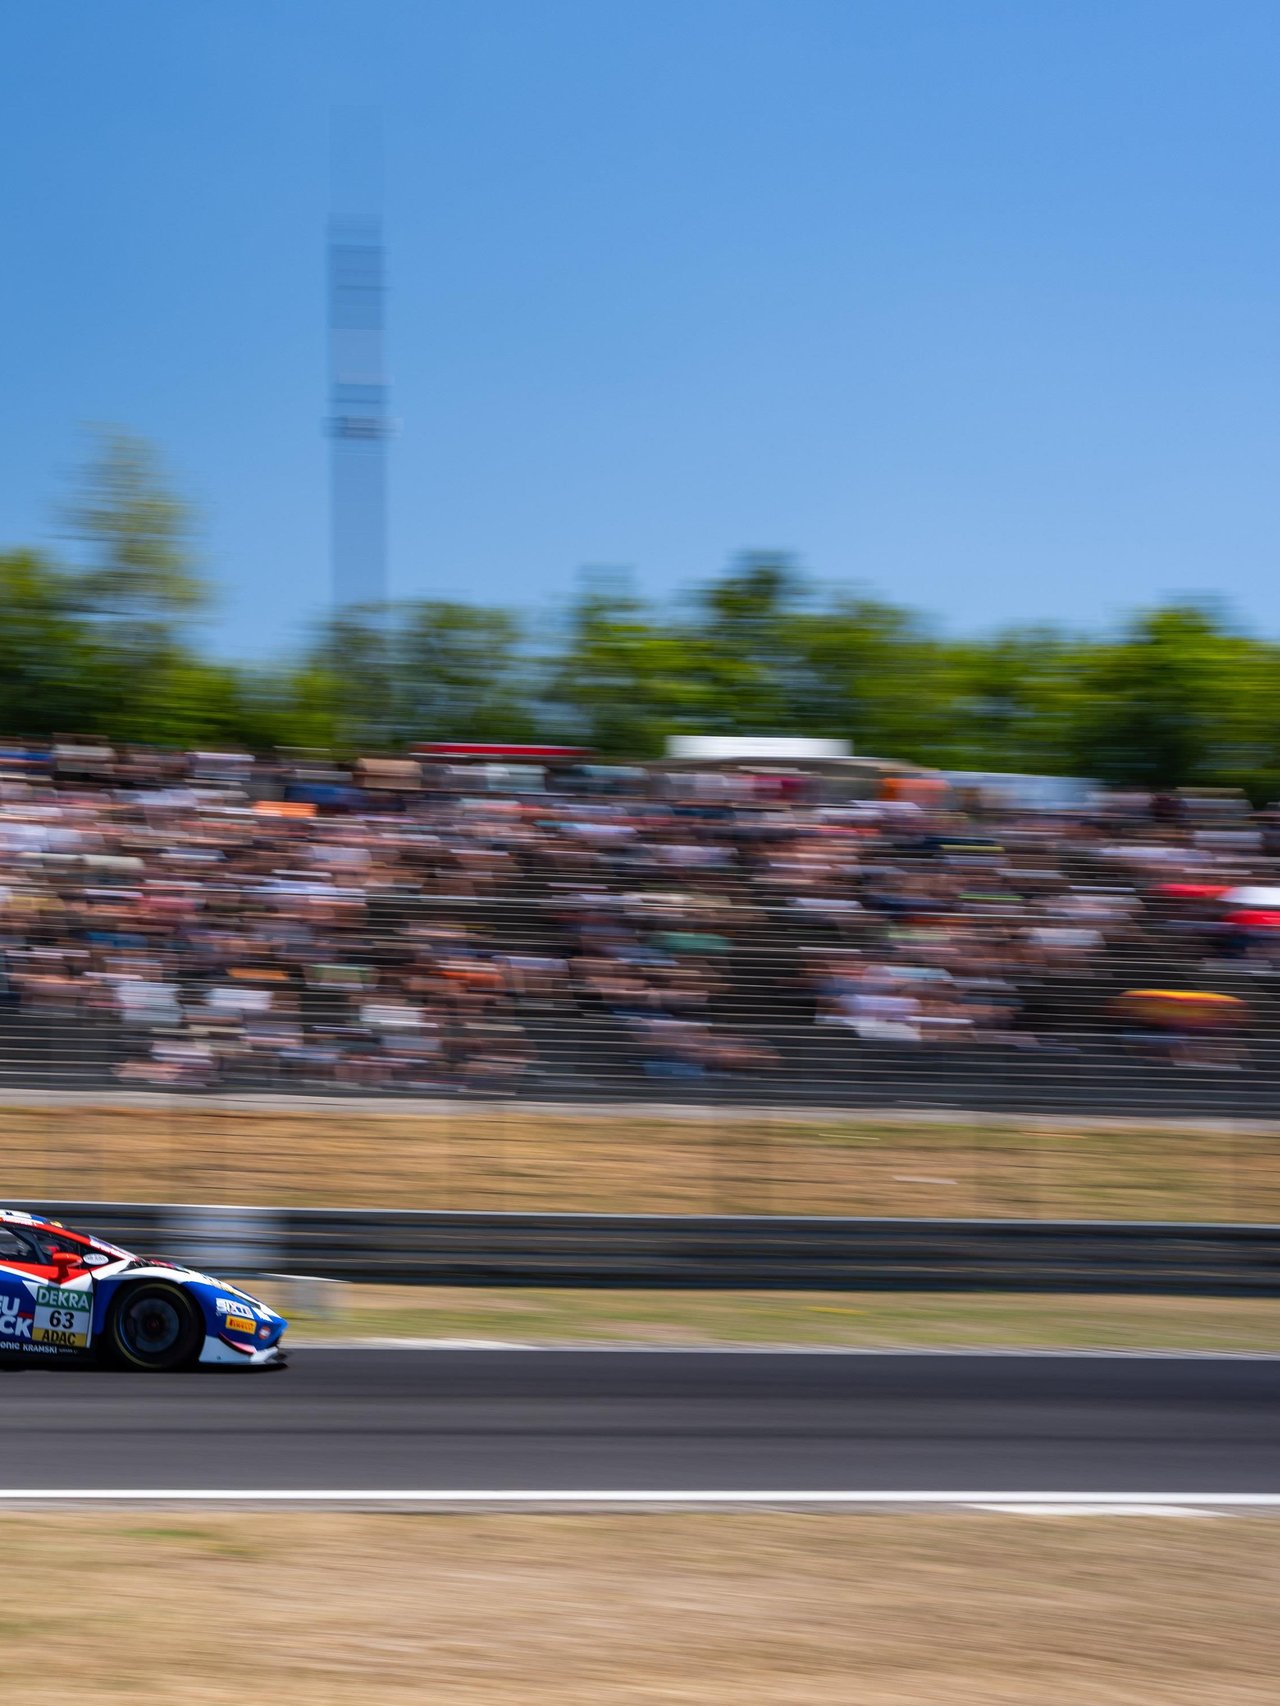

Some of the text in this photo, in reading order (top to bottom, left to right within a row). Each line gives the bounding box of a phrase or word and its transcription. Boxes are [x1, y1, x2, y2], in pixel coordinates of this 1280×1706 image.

[38, 1289, 89, 1309] DEKRA
[49, 1310, 75, 1329] 63
[42, 1329, 76, 1346] ADAC
